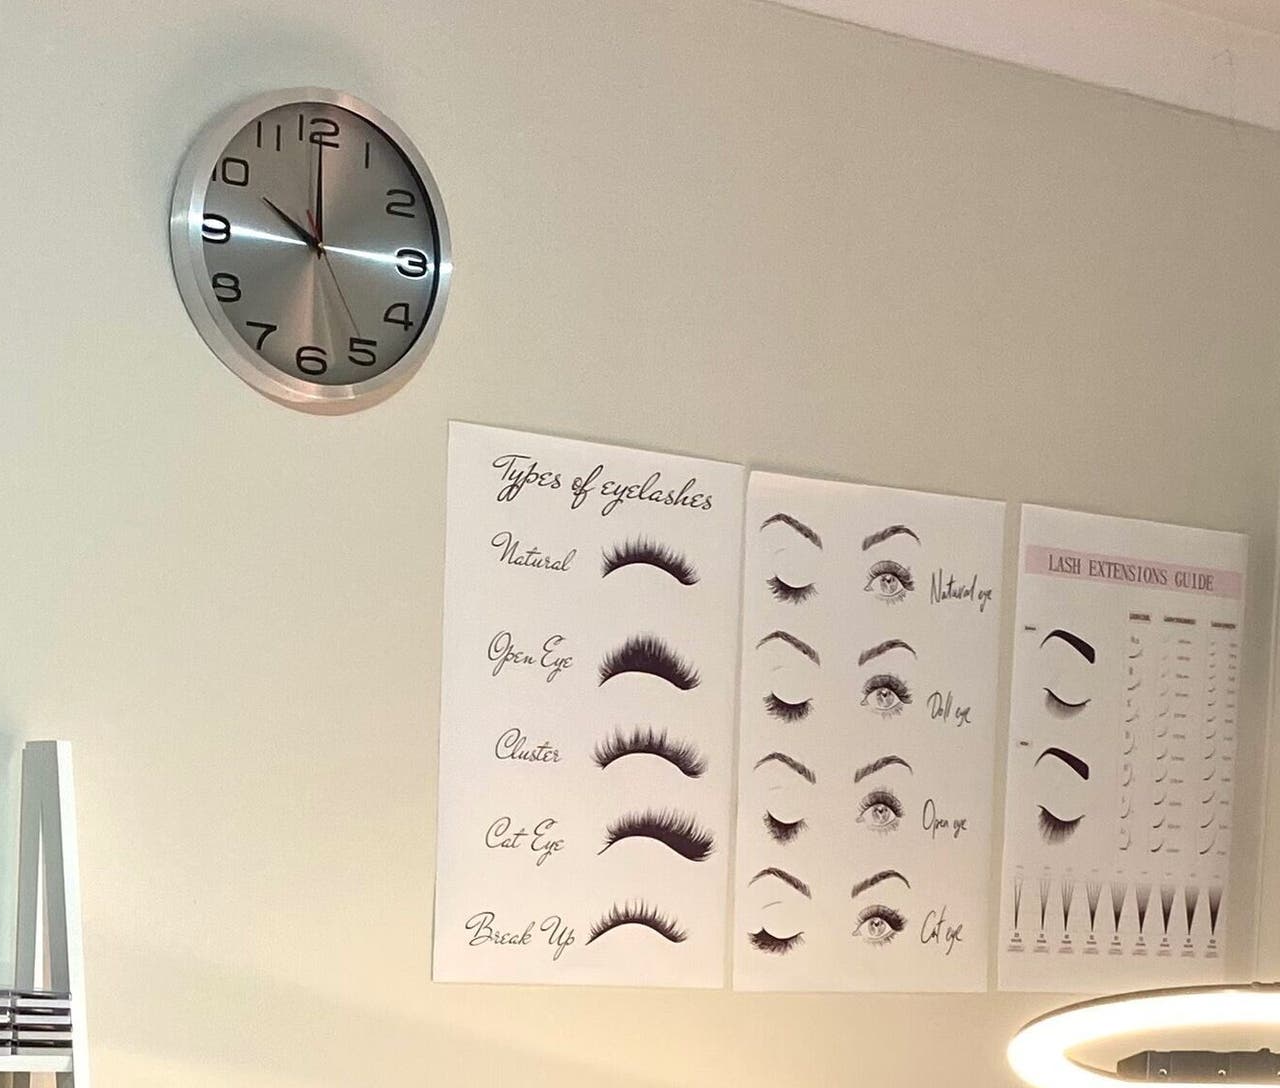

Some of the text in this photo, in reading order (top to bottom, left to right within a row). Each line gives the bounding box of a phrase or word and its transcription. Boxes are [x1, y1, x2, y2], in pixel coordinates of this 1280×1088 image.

[256, 120, 281, 151] 11
[297, 113, 340, 148] 12
[364, 142, 370, 169] 1
[385, 188, 416, 218] 2
[201, 213, 231, 244] 9
[394, 248, 428, 279] 3
[211, 272, 242, 303] 8
[383, 302, 414, 331] 4
[246, 320, 277, 350] 7
[348, 336, 377, 367] 5
[295, 345, 328, 376] 6
[492, 454, 713, 517] Types of eyelashes
[491, 531, 577, 572] Natural
[1048, 554, 1214, 591] LASH EXTENSIONS GUIDE
[930, 568, 992, 613] Natural eye
[488, 630, 573, 683] Open Eye
[927, 690, 971, 727] Doll eye
[495, 728, 562, 763] Cluster
[922, 798, 967, 840] Open eye
[485, 817, 565, 866] Cat Eye
[465, 911, 575, 961] Break Up
[921, 905, 963, 956] Cat eye
